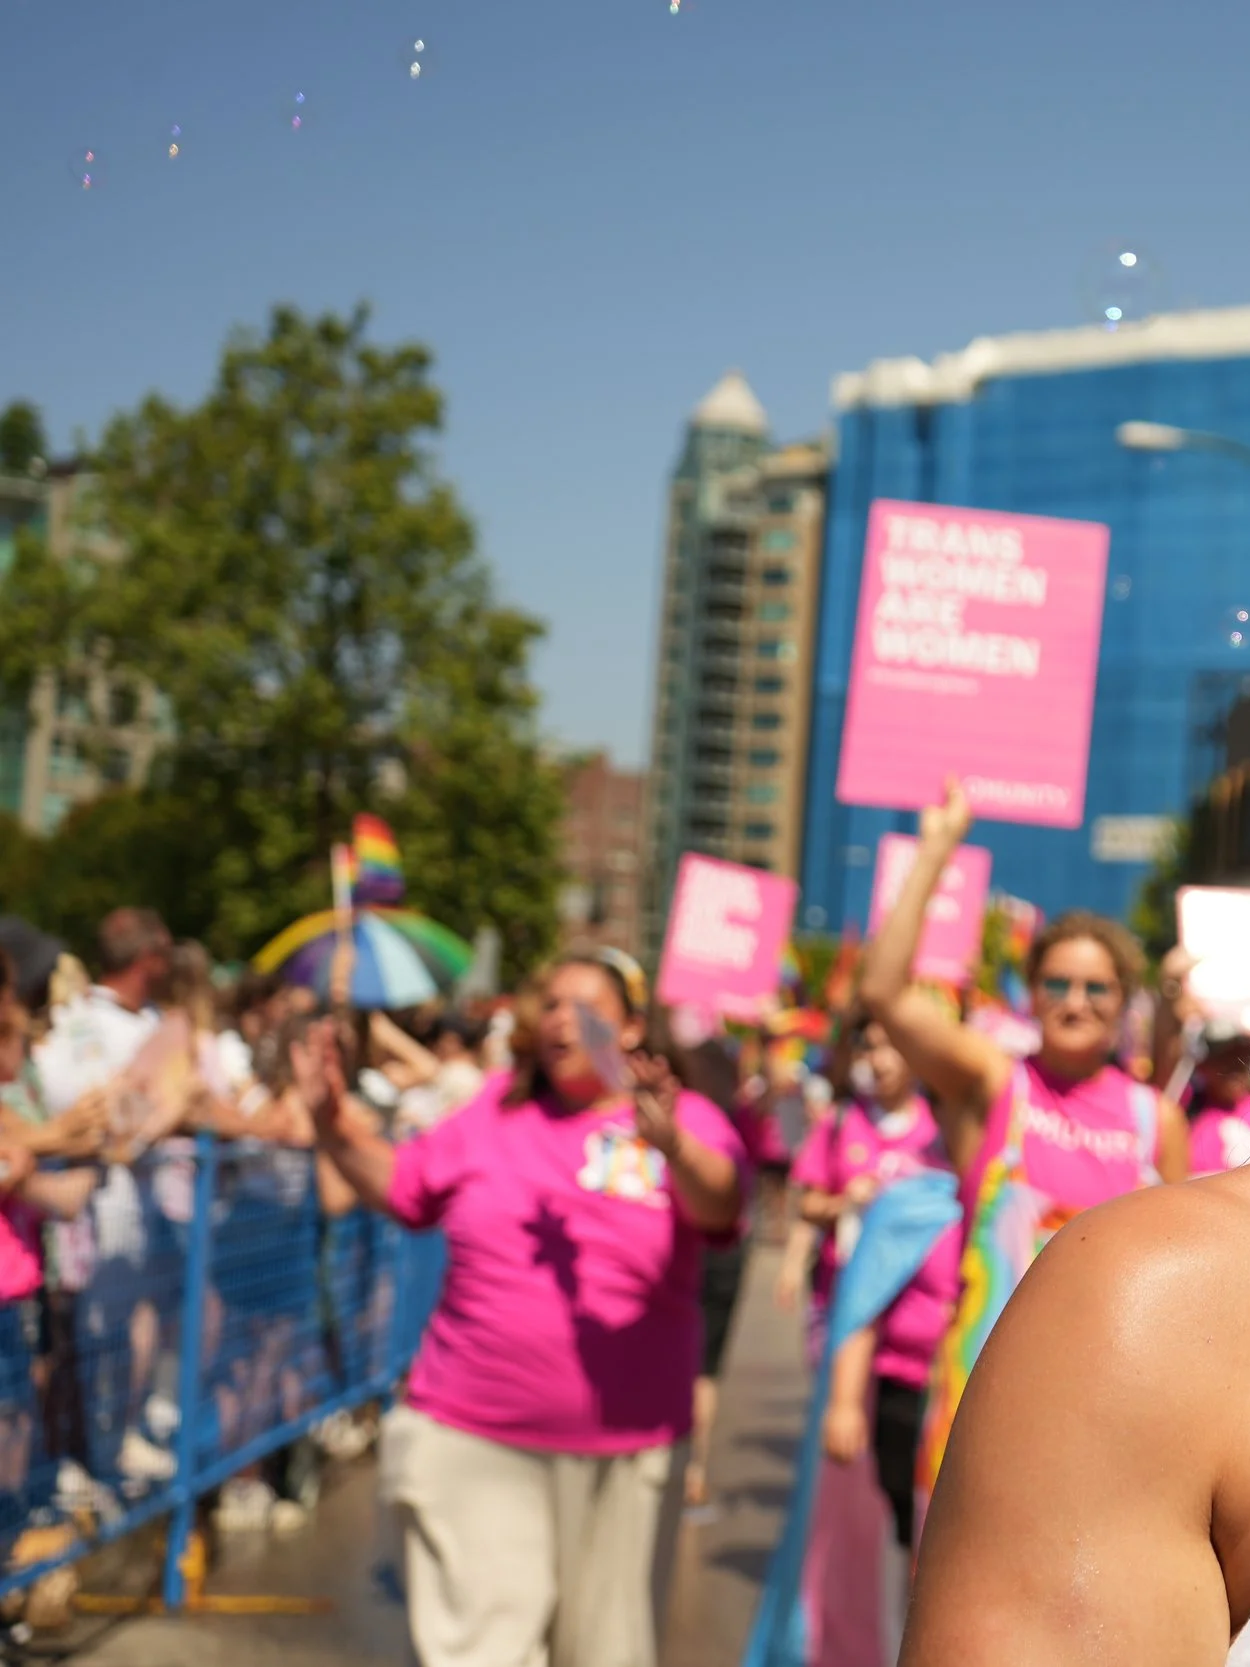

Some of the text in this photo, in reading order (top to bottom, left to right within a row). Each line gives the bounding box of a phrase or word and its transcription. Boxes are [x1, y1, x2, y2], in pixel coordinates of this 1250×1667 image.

[887, 514, 1023, 562] TRANS
[881, 552, 1047, 606] WOMEN
[874, 588, 964, 630] ARE
[873, 627, 1041, 679] WOMEN
